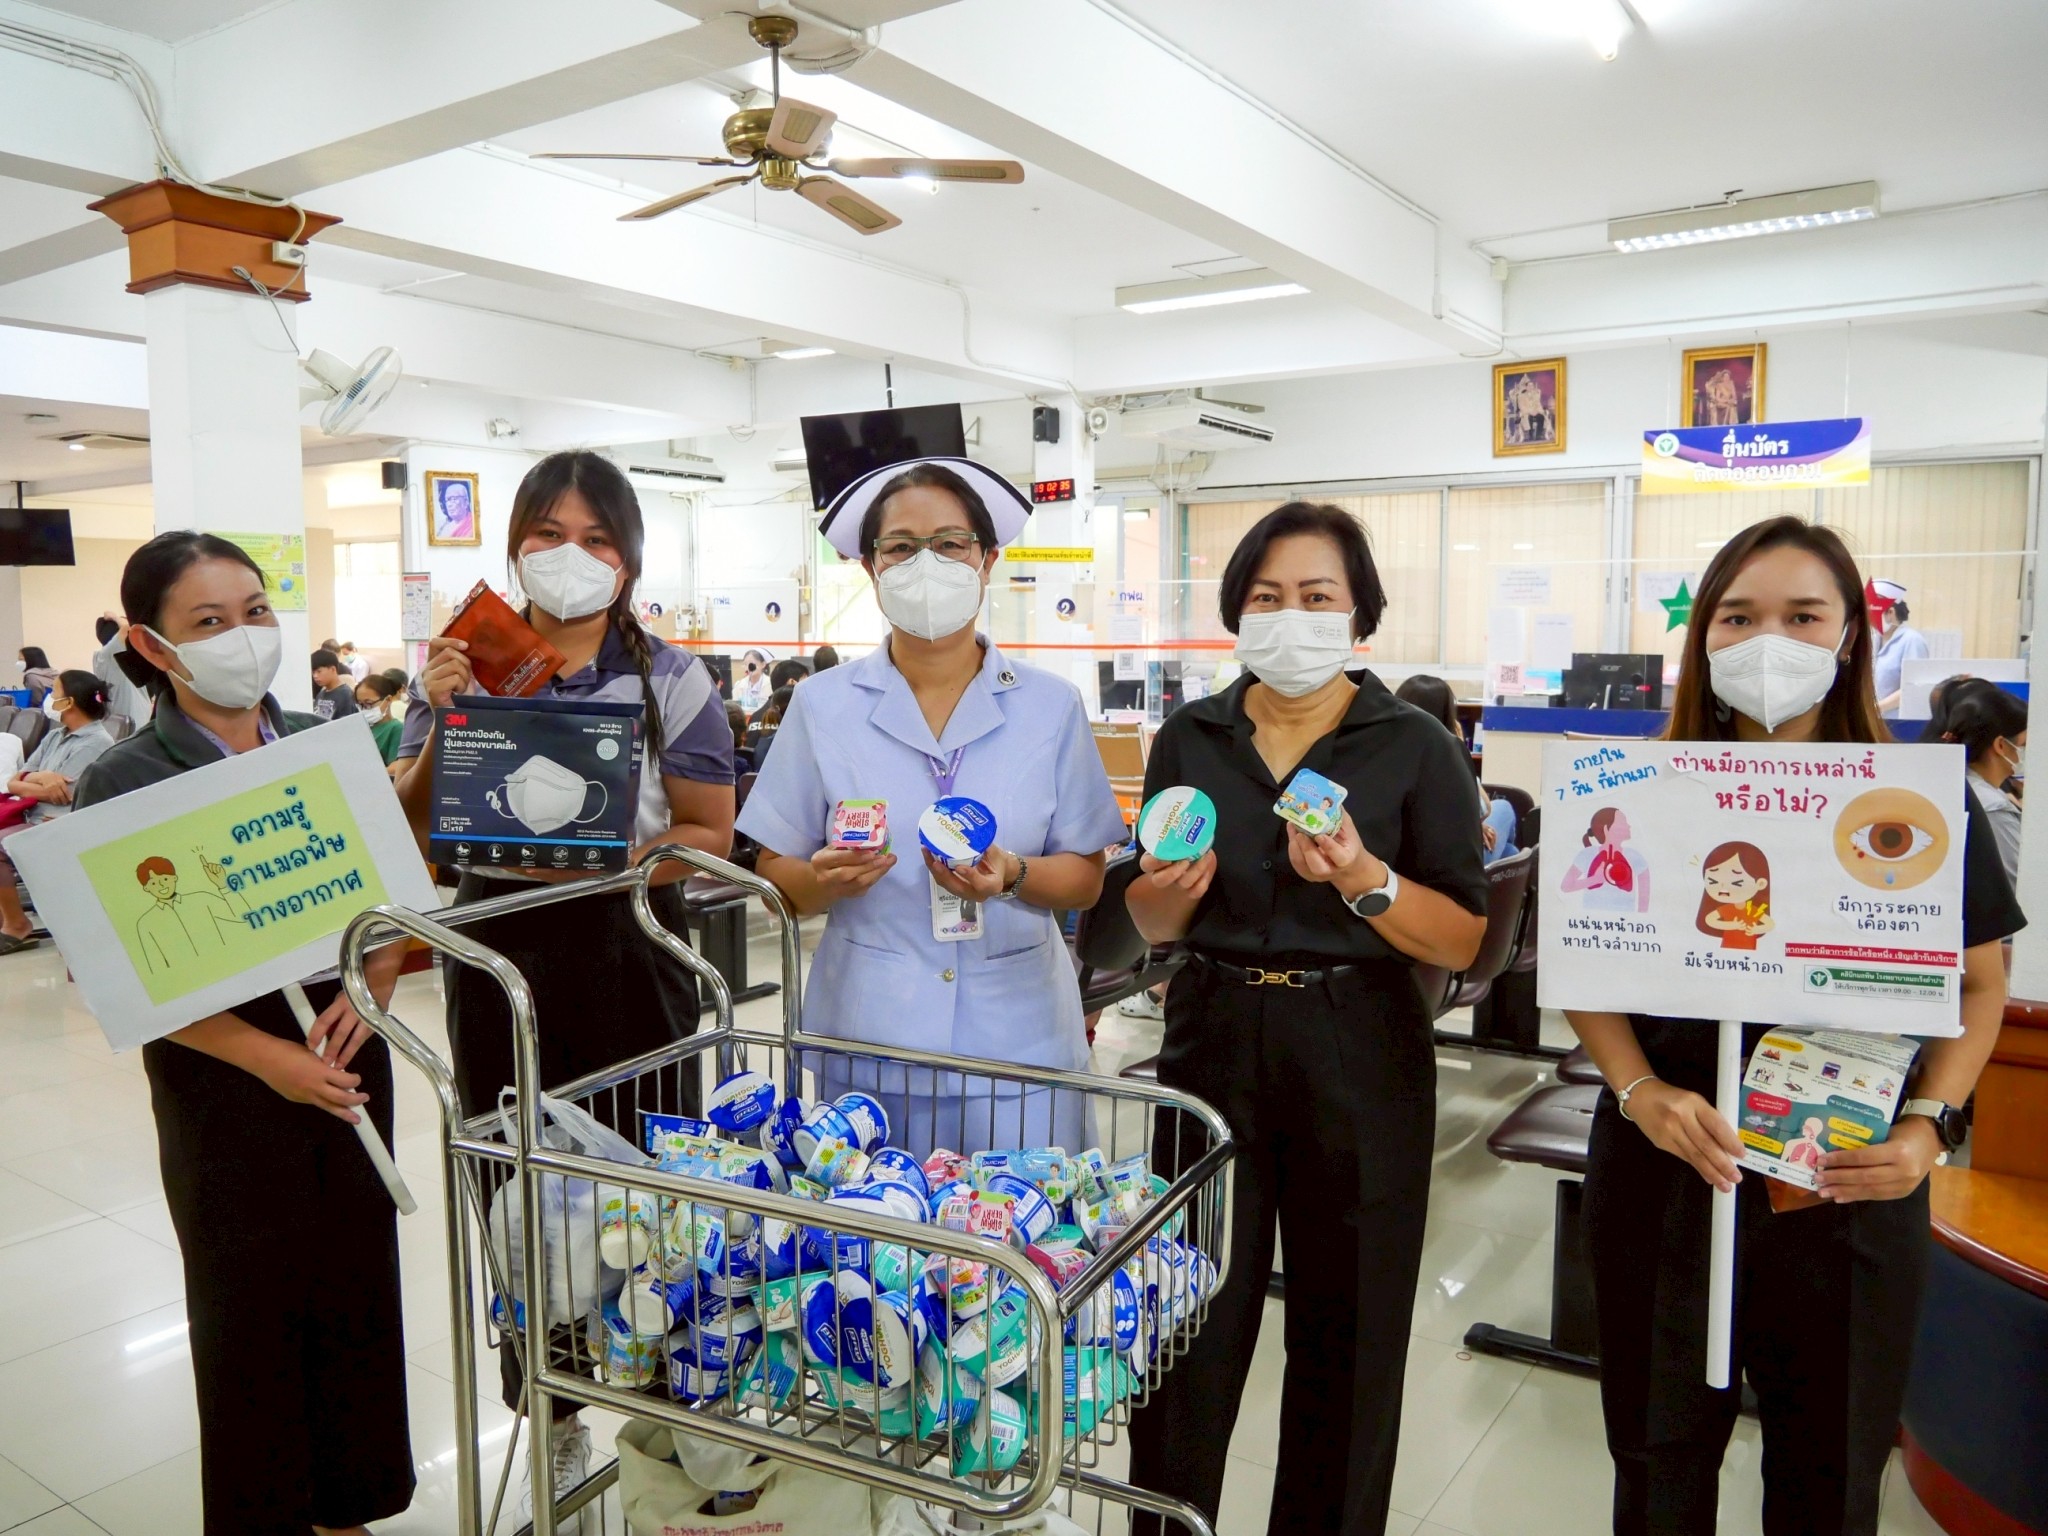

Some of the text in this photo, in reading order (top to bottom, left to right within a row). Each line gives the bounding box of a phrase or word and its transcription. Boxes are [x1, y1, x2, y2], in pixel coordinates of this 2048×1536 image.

[1722, 428, 1789, 458] ยื่นบัตร
[1046, 481, 1058, 492] 02
[651, 605, 660, 617] 5
[768, 606, 776, 619] 4
[1060, 601, 1070, 615] 2
[445, 714, 467, 726] 3M
[444, 728, 505, 740] หน้ากากป้องกัน
[444, 738, 517, 750] ฝุ่นละอองขนาดเล็ก
[1573, 747, 1626, 772] ภายใน
[1672, 751, 1876, 780] ท่านมีอาการเหล่านี้
[1572, 776, 1593, 798] วัน
[1597, 763, 1658, 791] ที่ผ่านมา
[1716, 783, 1829, 819] หรือไม่?
[232, 787, 312, 846] ความรู้
[845, 818, 870, 828] STRAW
[847, 812, 870, 820] BERRY
[1157, 800, 1184, 841] YOGHURT
[936, 815, 970, 846] YOGHURT
[221, 832, 347, 894] ด้านมลพิษ
[243, 868, 364, 931] ทางอากาศ
[1838, 898, 1942, 918] มีการระคาย
[1567, 916, 1657, 936] แน่นหน้าอก
[1562, 934, 1662, 954] หายใจลำบาก
[1684, 952, 1784, 976] มีเจ็บหน้าอก
[982, 1209, 1003, 1220] BERRY
